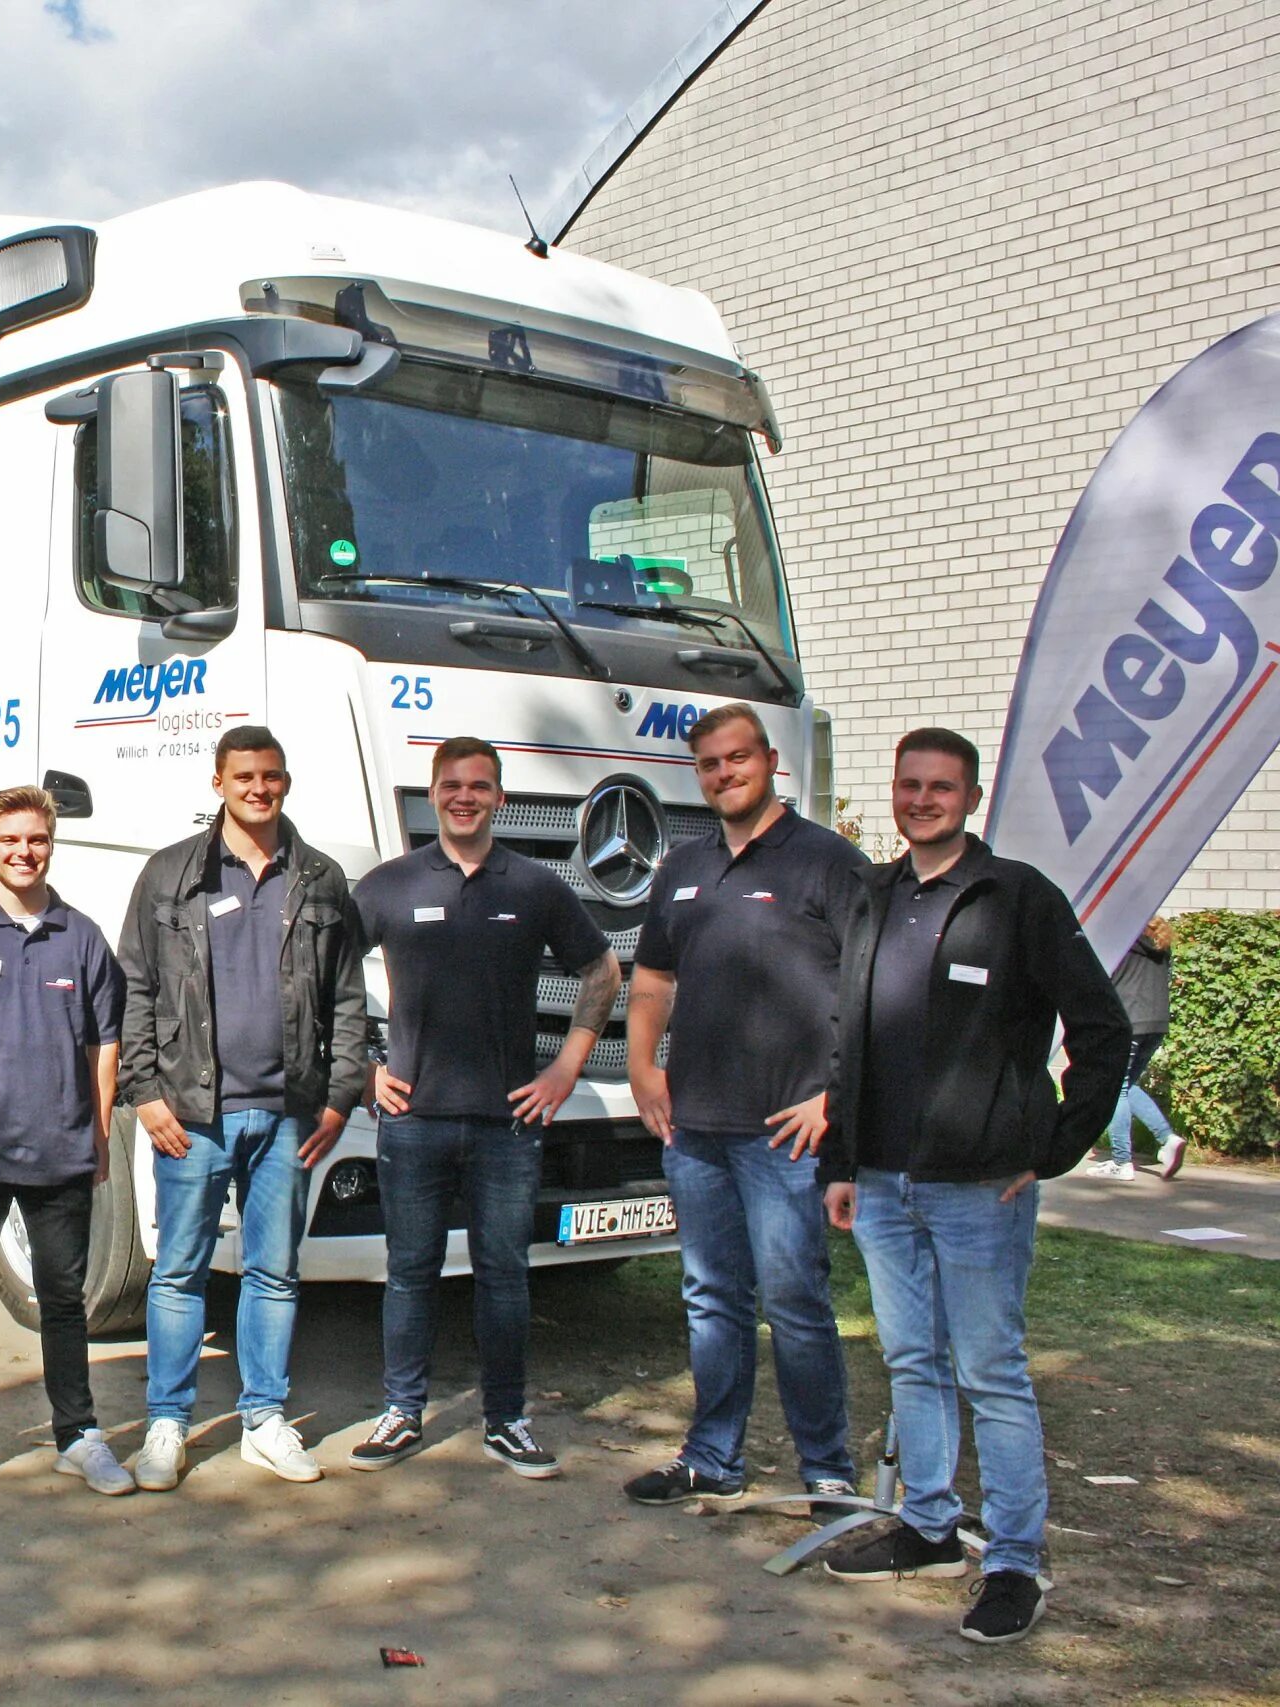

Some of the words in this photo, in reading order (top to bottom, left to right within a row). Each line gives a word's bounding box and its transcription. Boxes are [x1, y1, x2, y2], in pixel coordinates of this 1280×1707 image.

[339, 541, 347, 553] 4
[390, 674, 433, 711] 25
[157, 708, 223, 736] logistics
[116, 744, 149, 760] Willich
[169, 742, 200, 757] 02154
[574, 1207, 608, 1236] VIE
